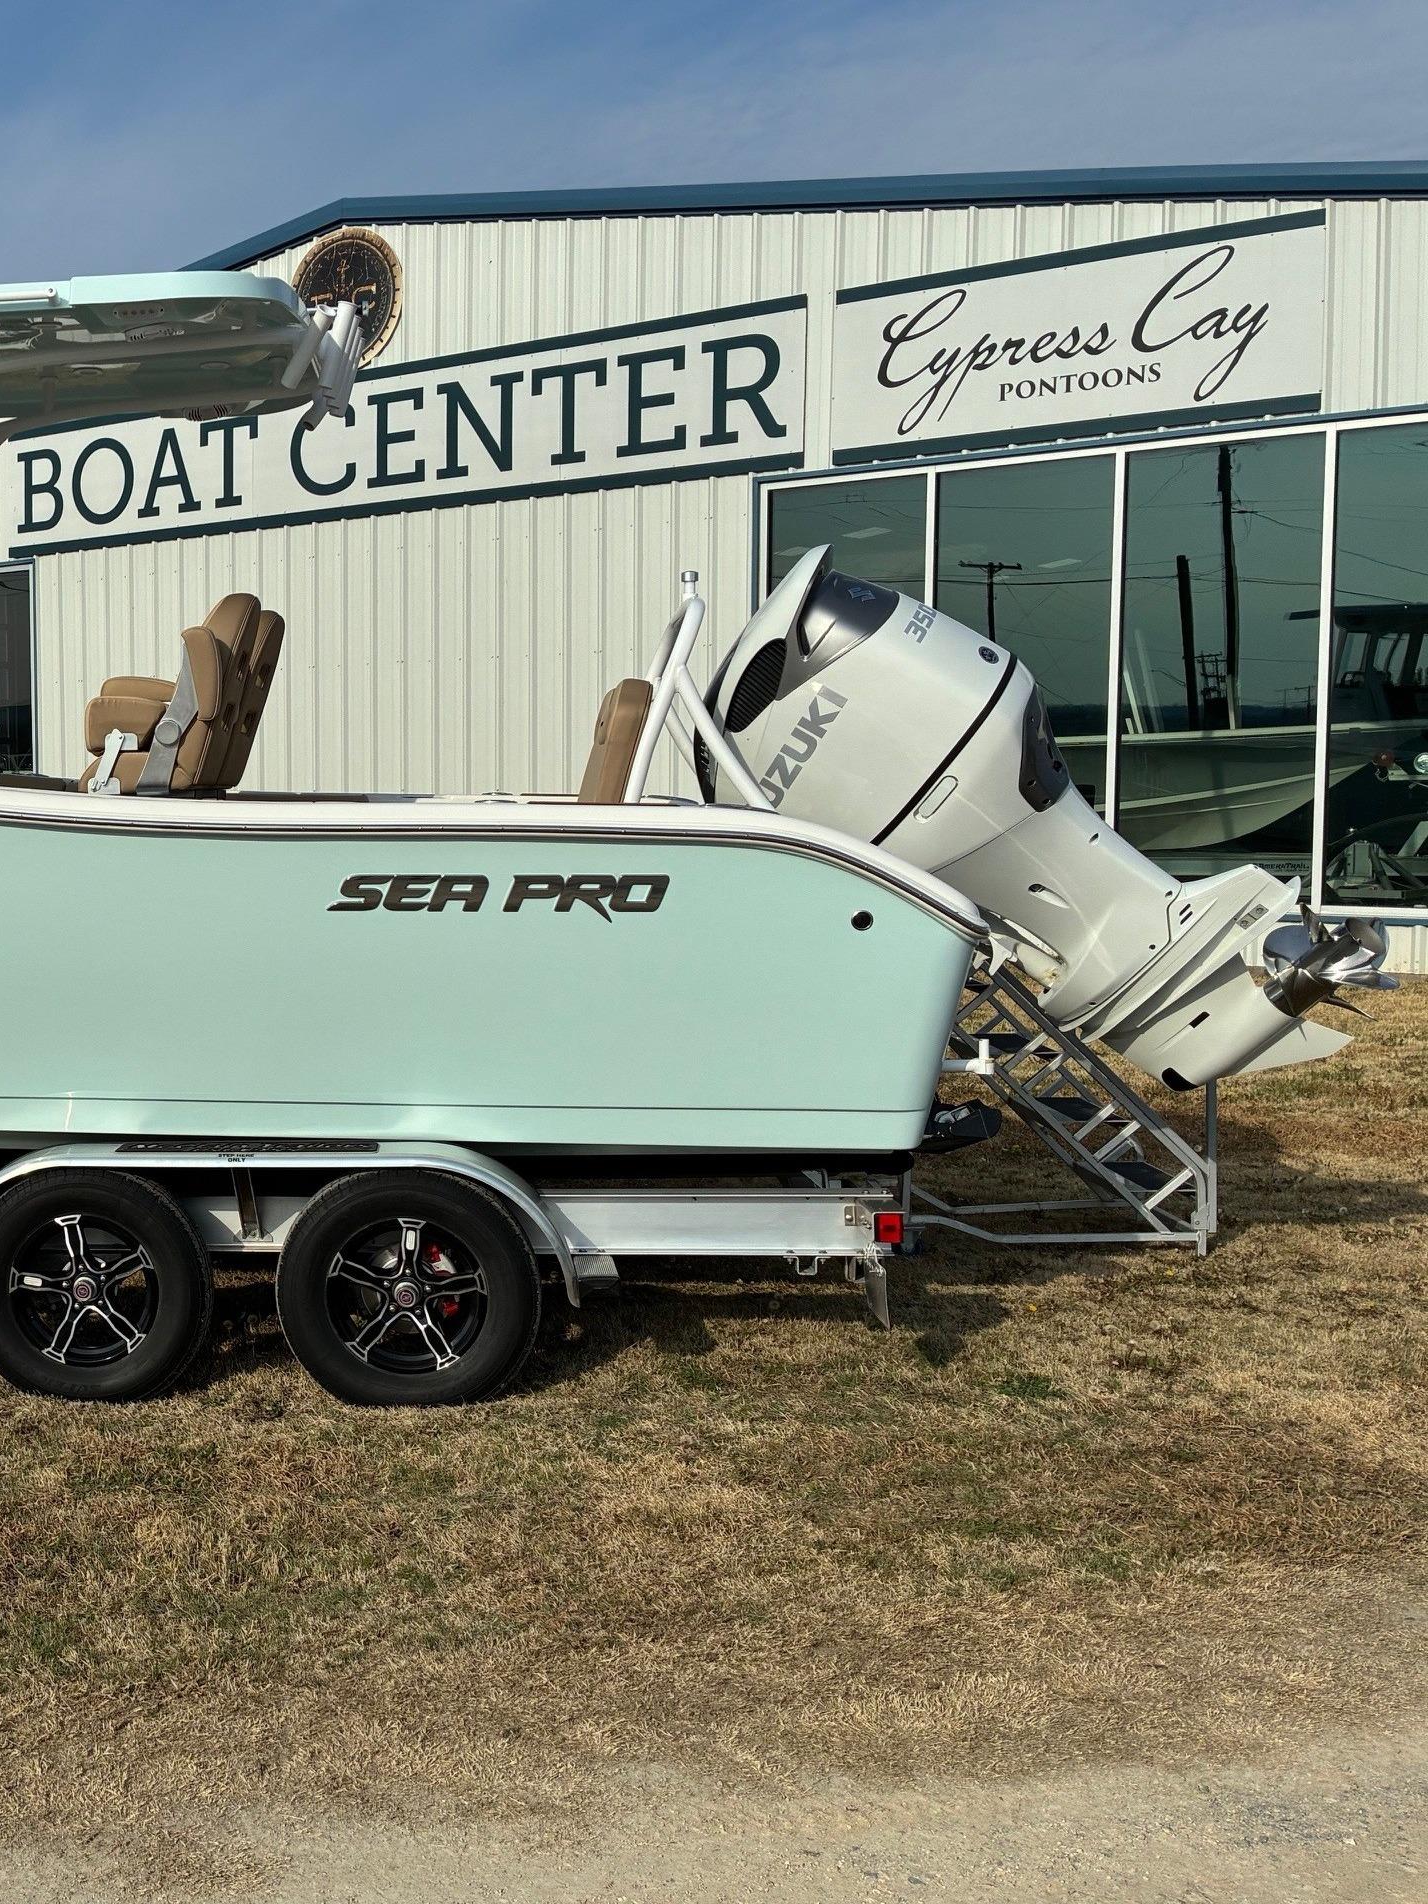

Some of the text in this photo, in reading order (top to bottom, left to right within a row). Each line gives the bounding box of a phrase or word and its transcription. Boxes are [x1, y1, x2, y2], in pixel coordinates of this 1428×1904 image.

[876, 244, 1270, 436] Cypress Cay
[998, 363, 1163, 402] PONTOONS
[17, 333, 787, 534] BOAT CENTER
[903, 602, 939, 644] 350
[758, 684, 849, 809] UZUKI
[326, 874, 671, 924] SEA PRO
